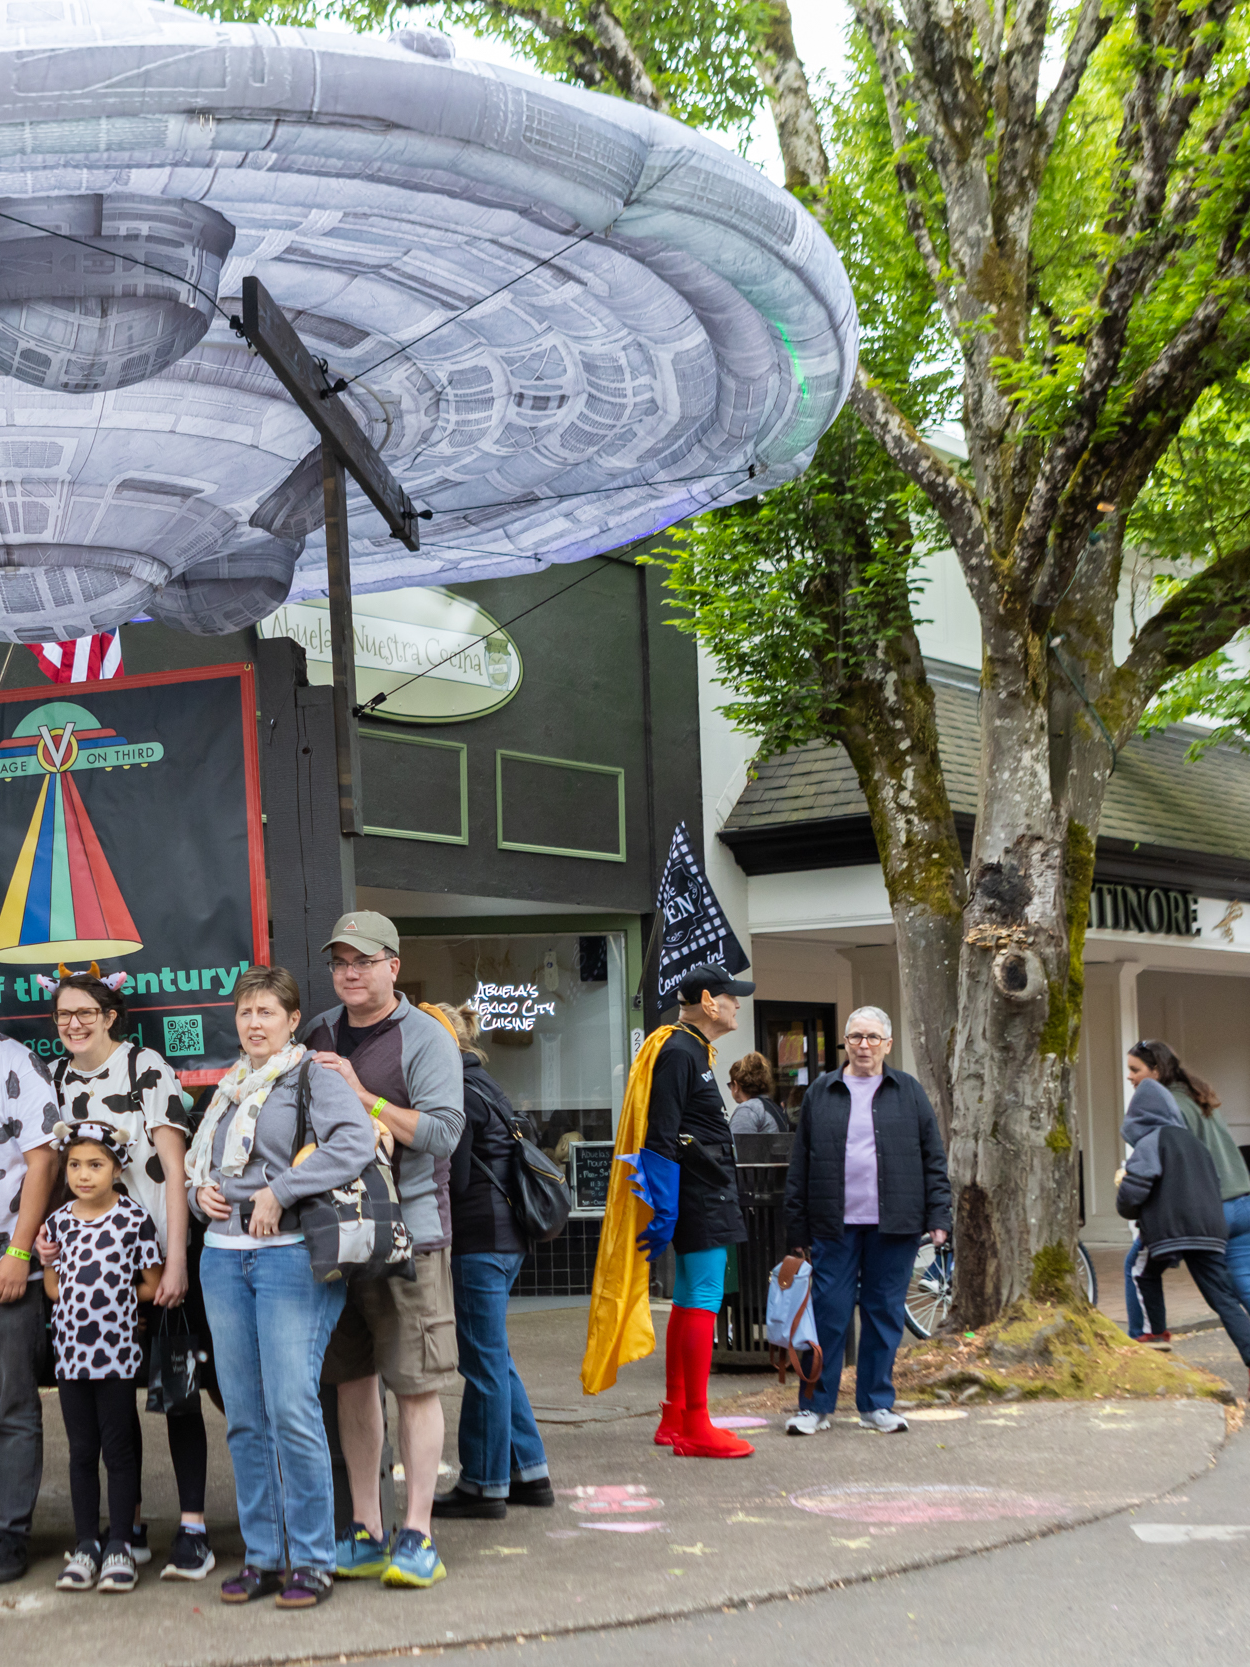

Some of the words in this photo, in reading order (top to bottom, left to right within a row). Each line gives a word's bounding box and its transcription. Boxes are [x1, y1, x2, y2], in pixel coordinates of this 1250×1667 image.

[353, 625, 423, 666] Nuestra
[425, 638, 484, 676] Cocina
[86, 752, 107, 765] ON
[114, 747, 155, 762] THIRD
[666, 892, 695, 925] EN
[1088, 882, 1202, 937] TINORE
[123, 960, 250, 996] entury!
